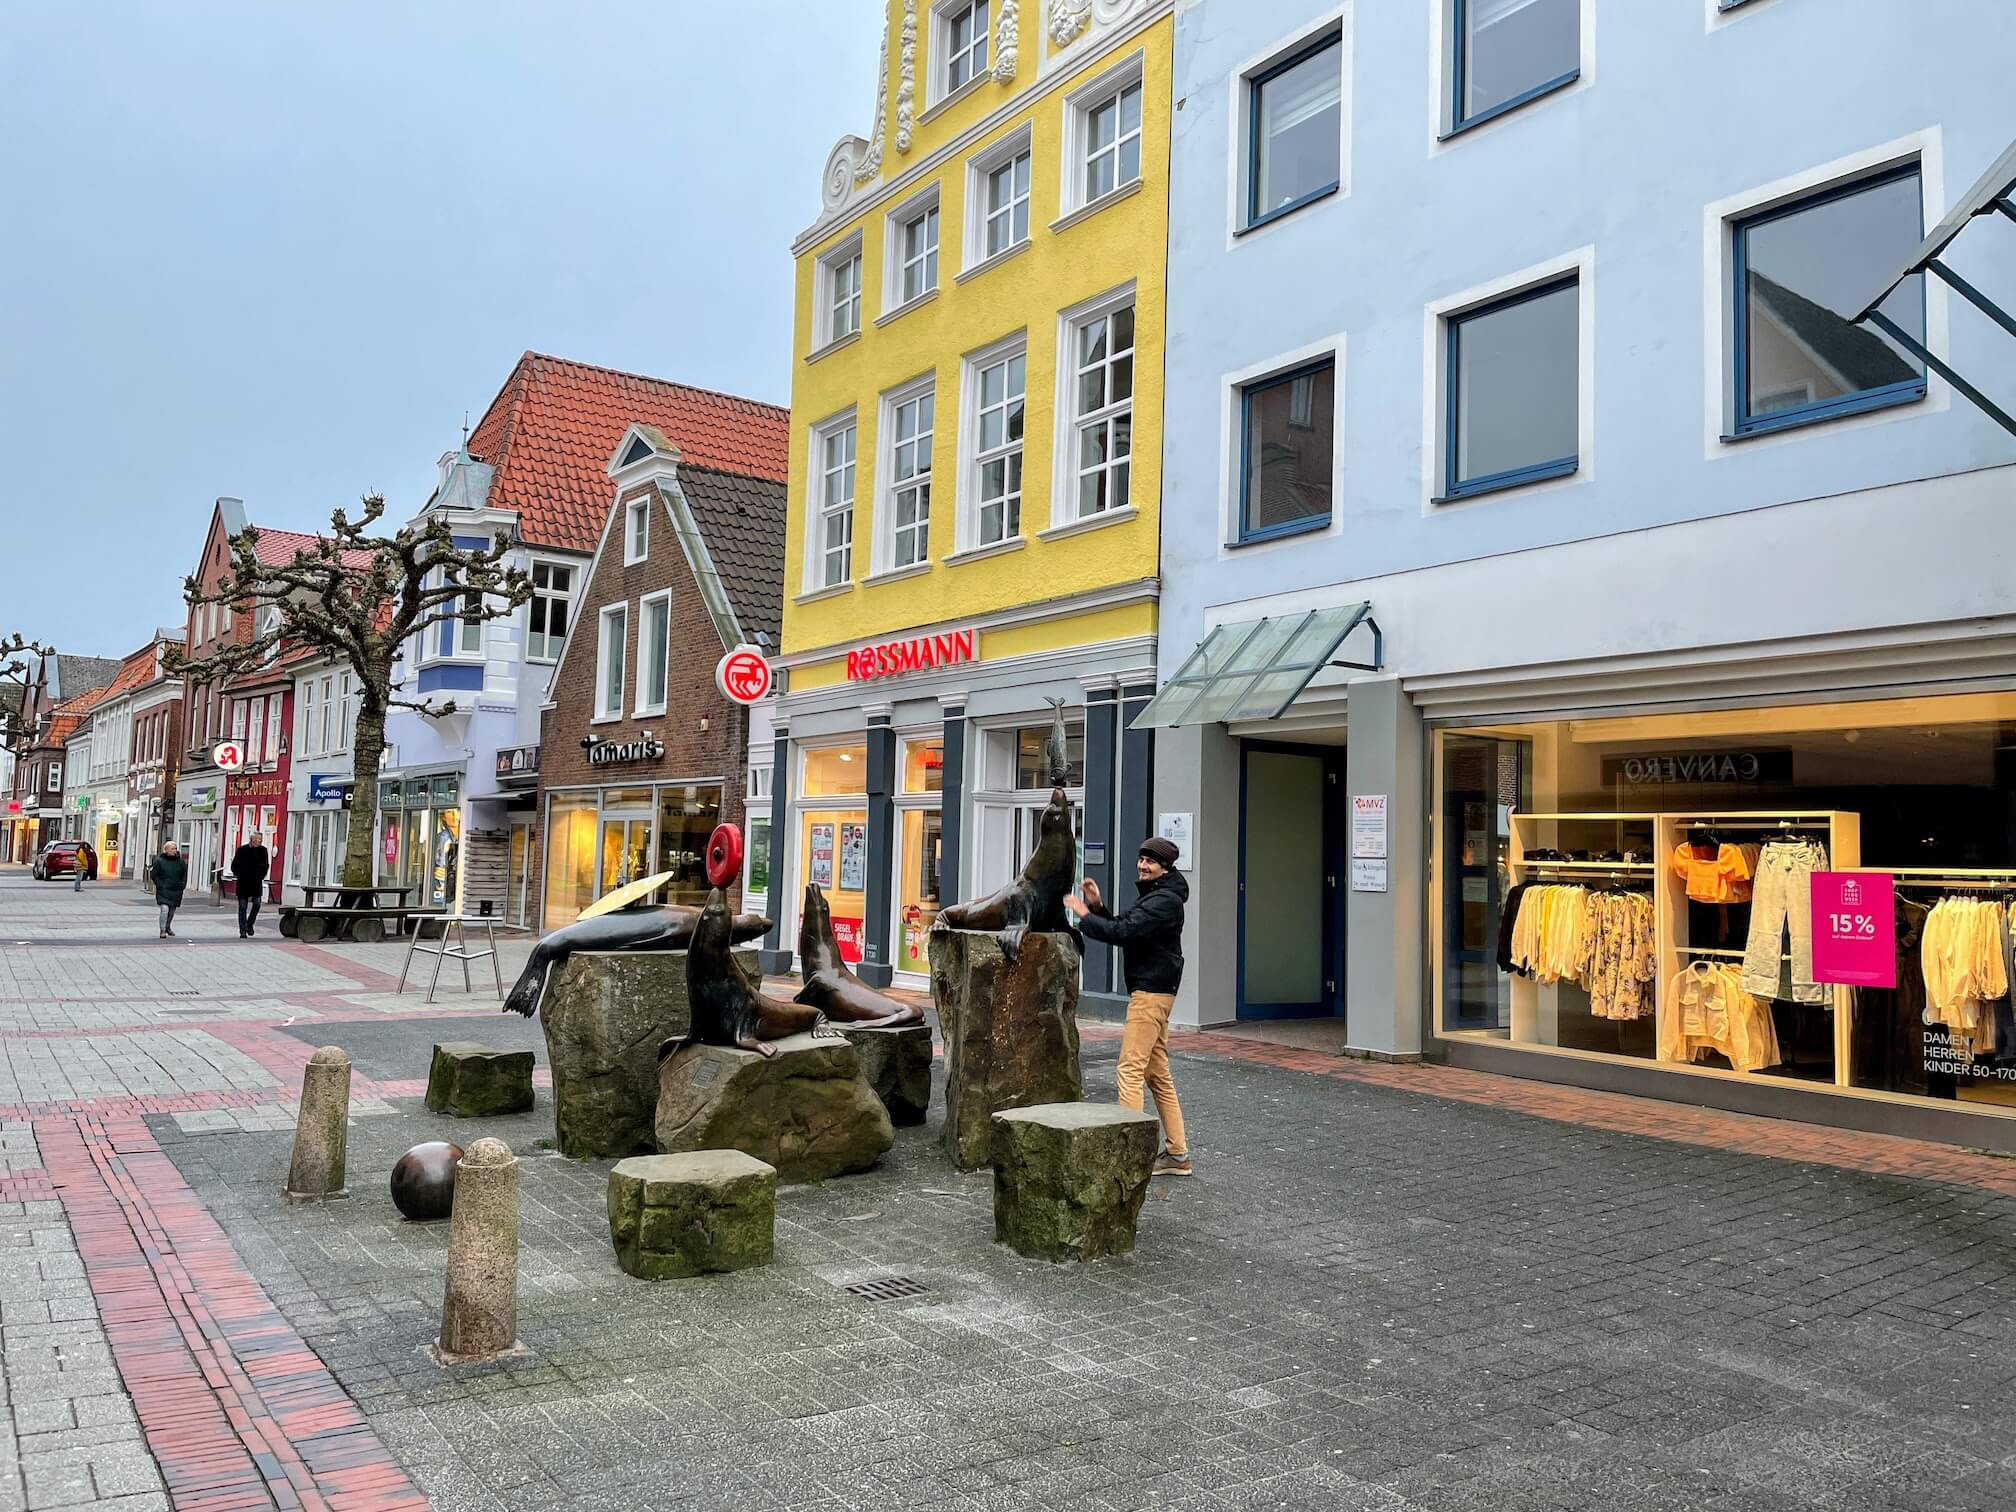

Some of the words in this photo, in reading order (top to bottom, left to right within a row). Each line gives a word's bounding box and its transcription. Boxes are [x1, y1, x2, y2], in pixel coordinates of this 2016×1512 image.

[847, 628, 974, 681] ROSSMANN
[580, 729, 664, 765] Tamaris
[315, 788, 342, 799] Apollo
[1366, 799, 1384, 809] MVZ
[1923, 1031, 1970, 1047] DAMEN
[1923, 1045, 1975, 1062] HERREN
[1923, 1060, 1970, 1076] KINDER
